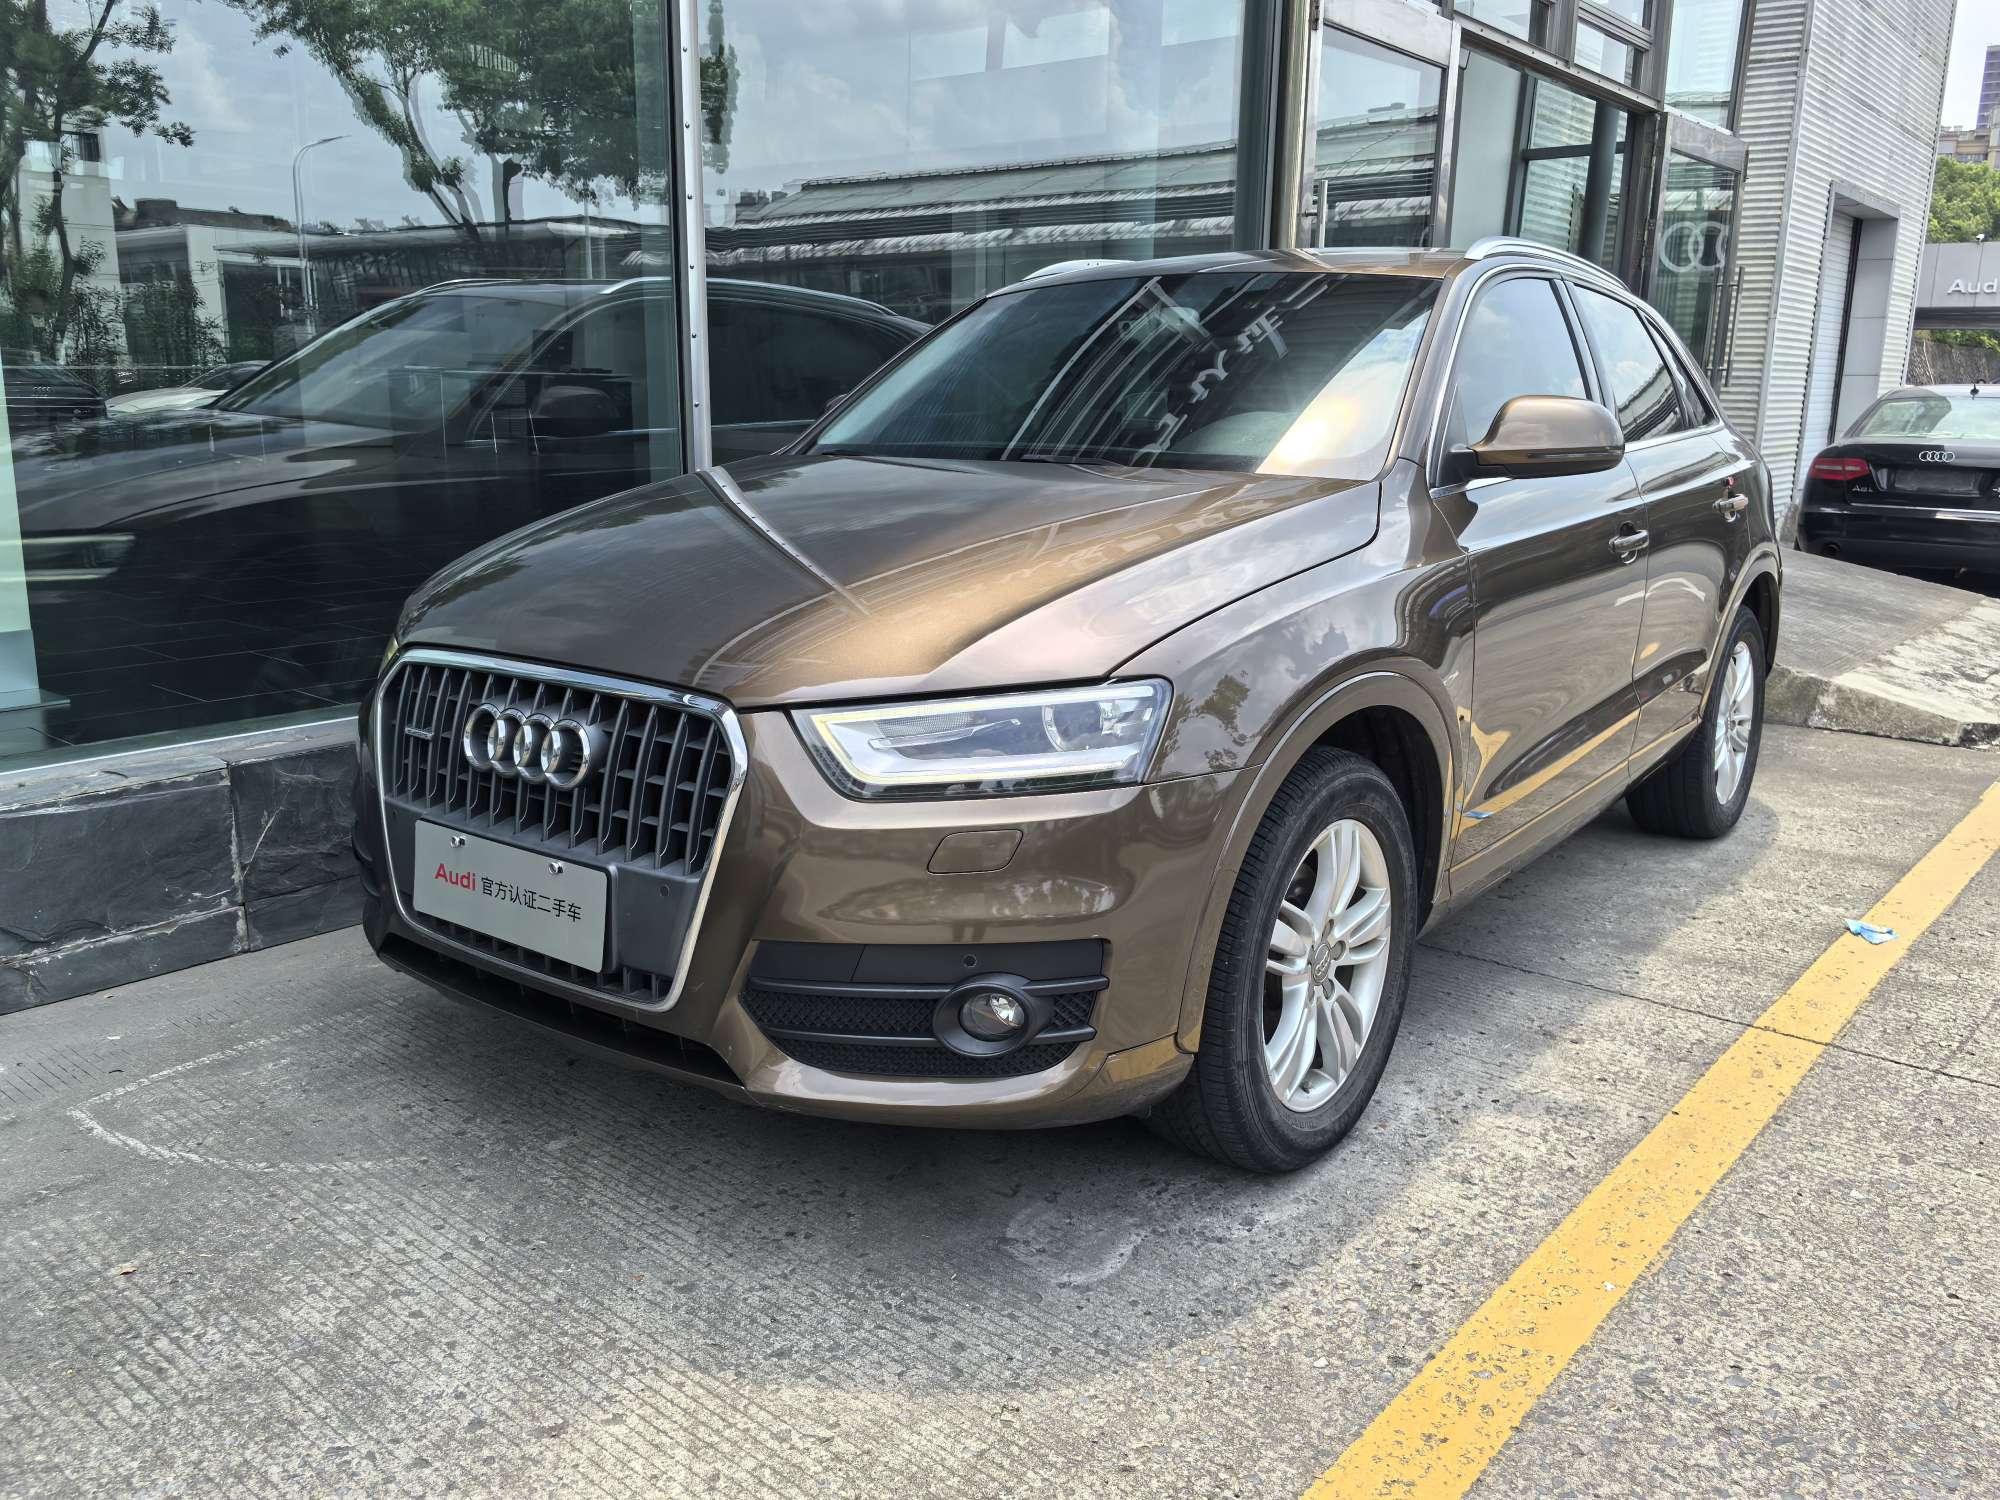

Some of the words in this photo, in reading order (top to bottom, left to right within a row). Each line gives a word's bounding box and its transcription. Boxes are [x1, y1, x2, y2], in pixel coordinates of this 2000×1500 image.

[434, 863, 476, 891] Audi
[481, 876, 582, 922] 官方认证二手车
